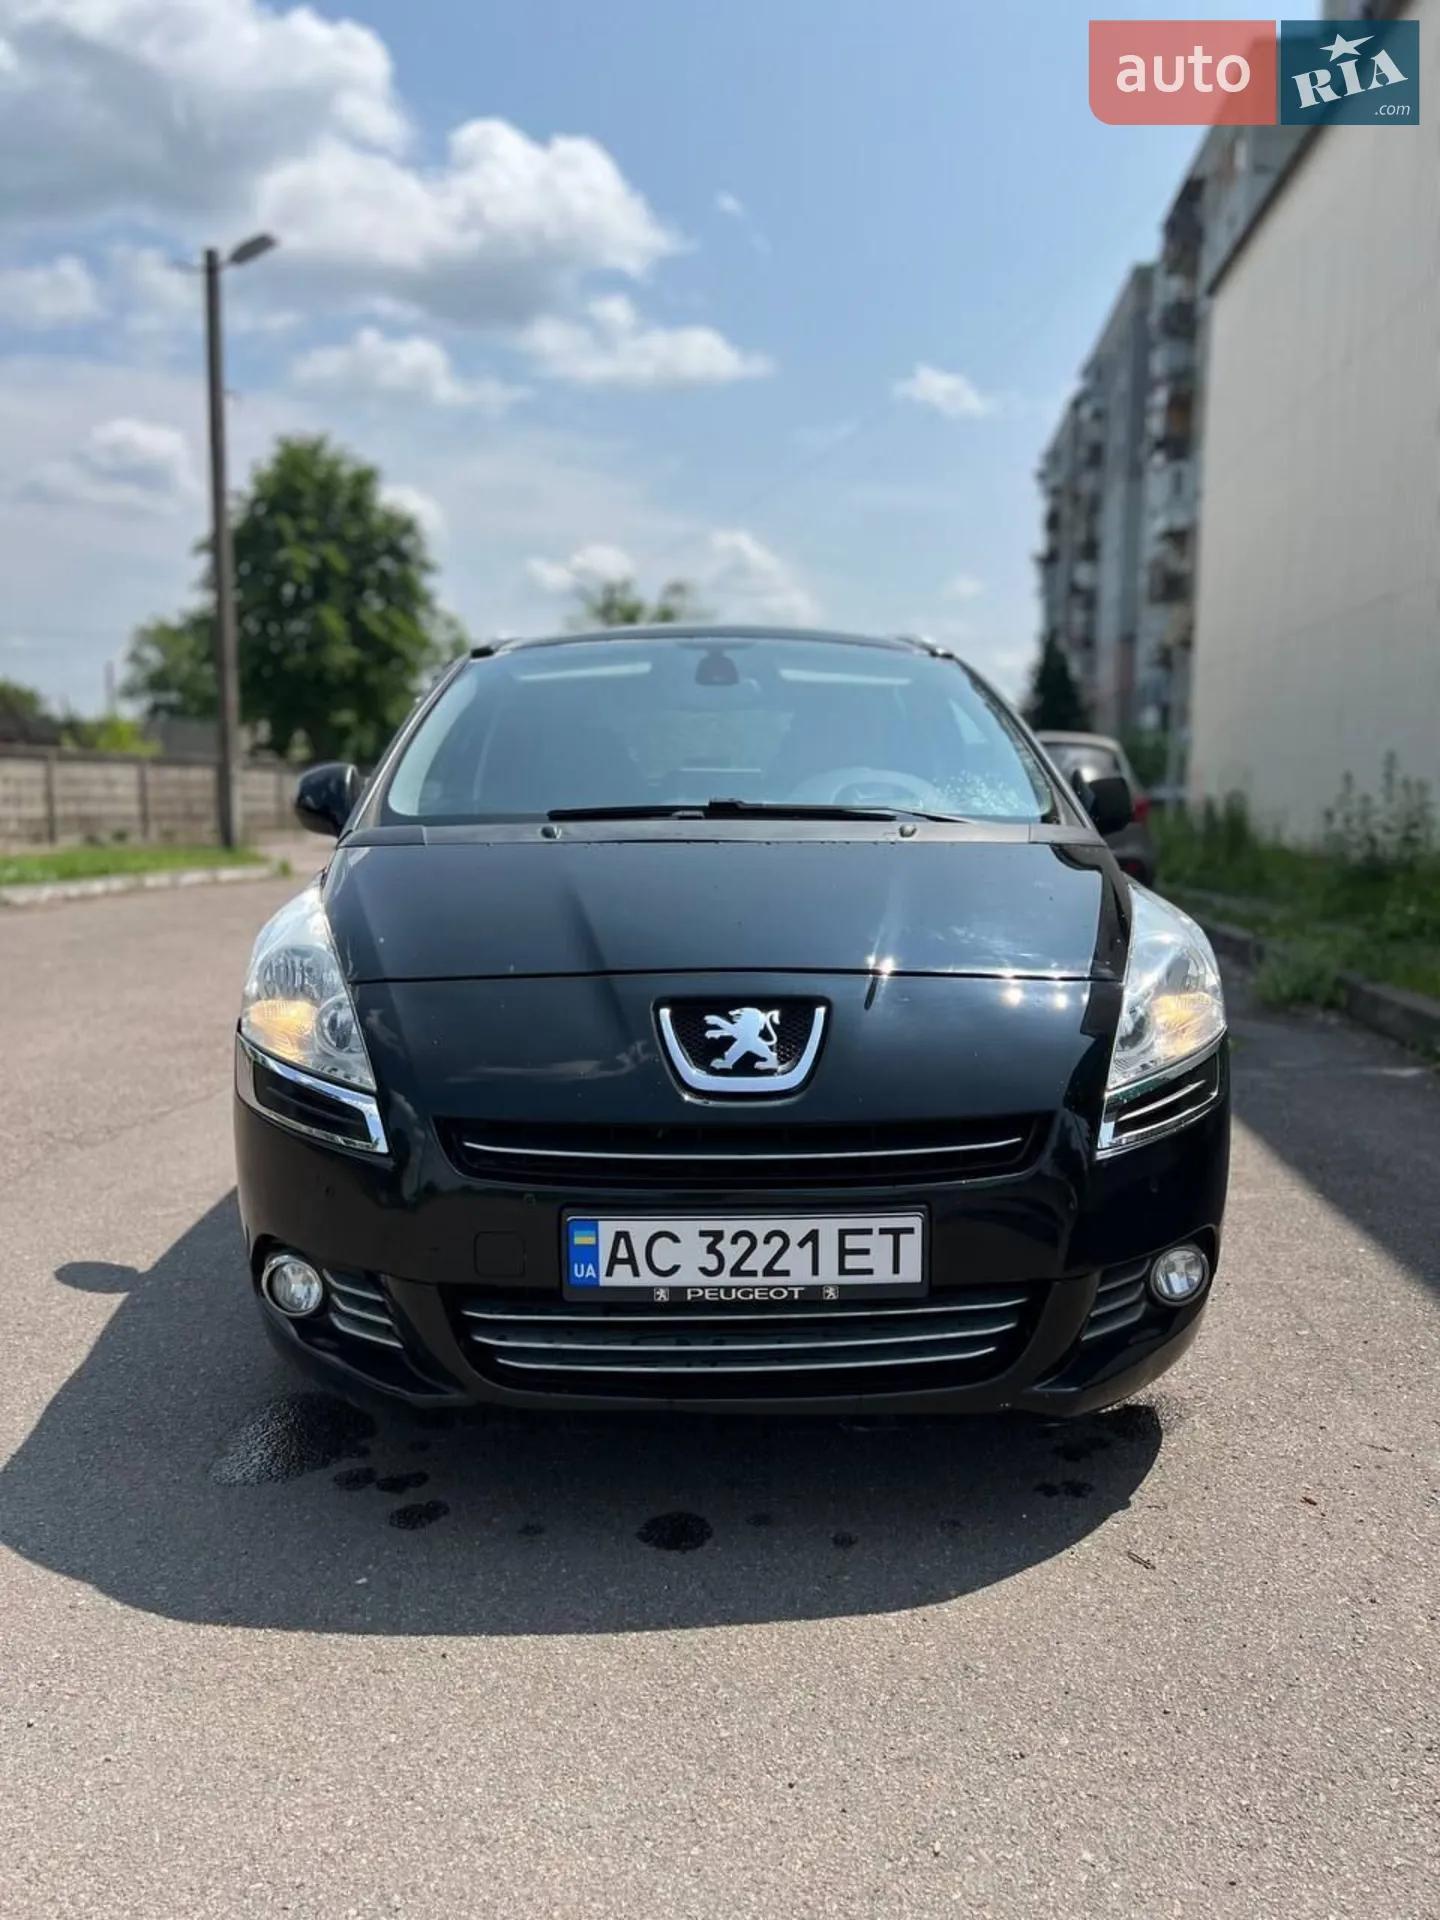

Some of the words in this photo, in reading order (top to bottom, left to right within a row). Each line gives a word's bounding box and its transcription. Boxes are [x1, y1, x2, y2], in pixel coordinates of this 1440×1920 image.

[605, 1230, 682, 1278] AC
[697, 1228, 820, 1278] 3221
[837, 1227, 915, 1277] ET
[573, 1263, 596, 1278] UA
[686, 1286, 805, 1301] PEUGEOT
